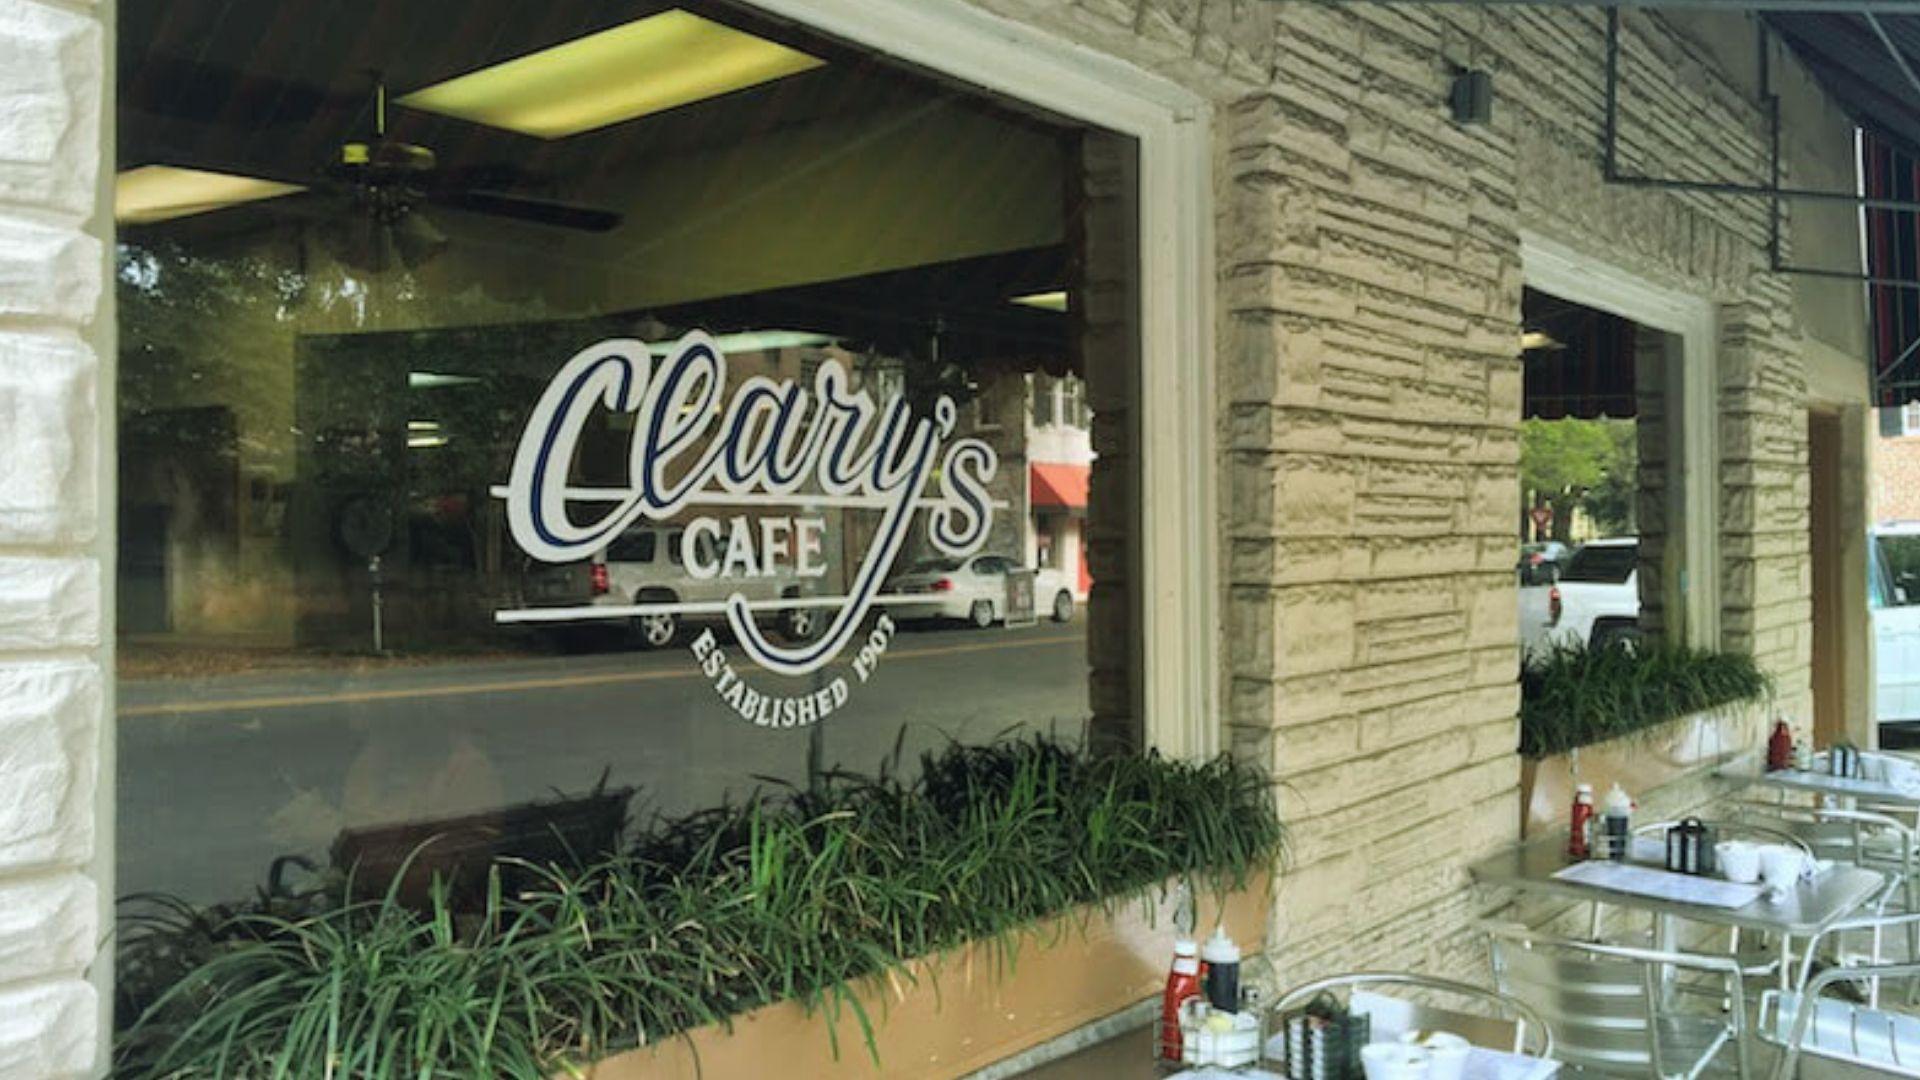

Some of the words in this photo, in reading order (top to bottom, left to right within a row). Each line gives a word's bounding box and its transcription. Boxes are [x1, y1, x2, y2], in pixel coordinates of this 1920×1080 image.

[507, 329, 997, 675] Clary's
[681, 516, 827, 580] CAFE
[690, 627, 848, 728] ESTABLISHED
[852, 613, 896, 682] 1903
